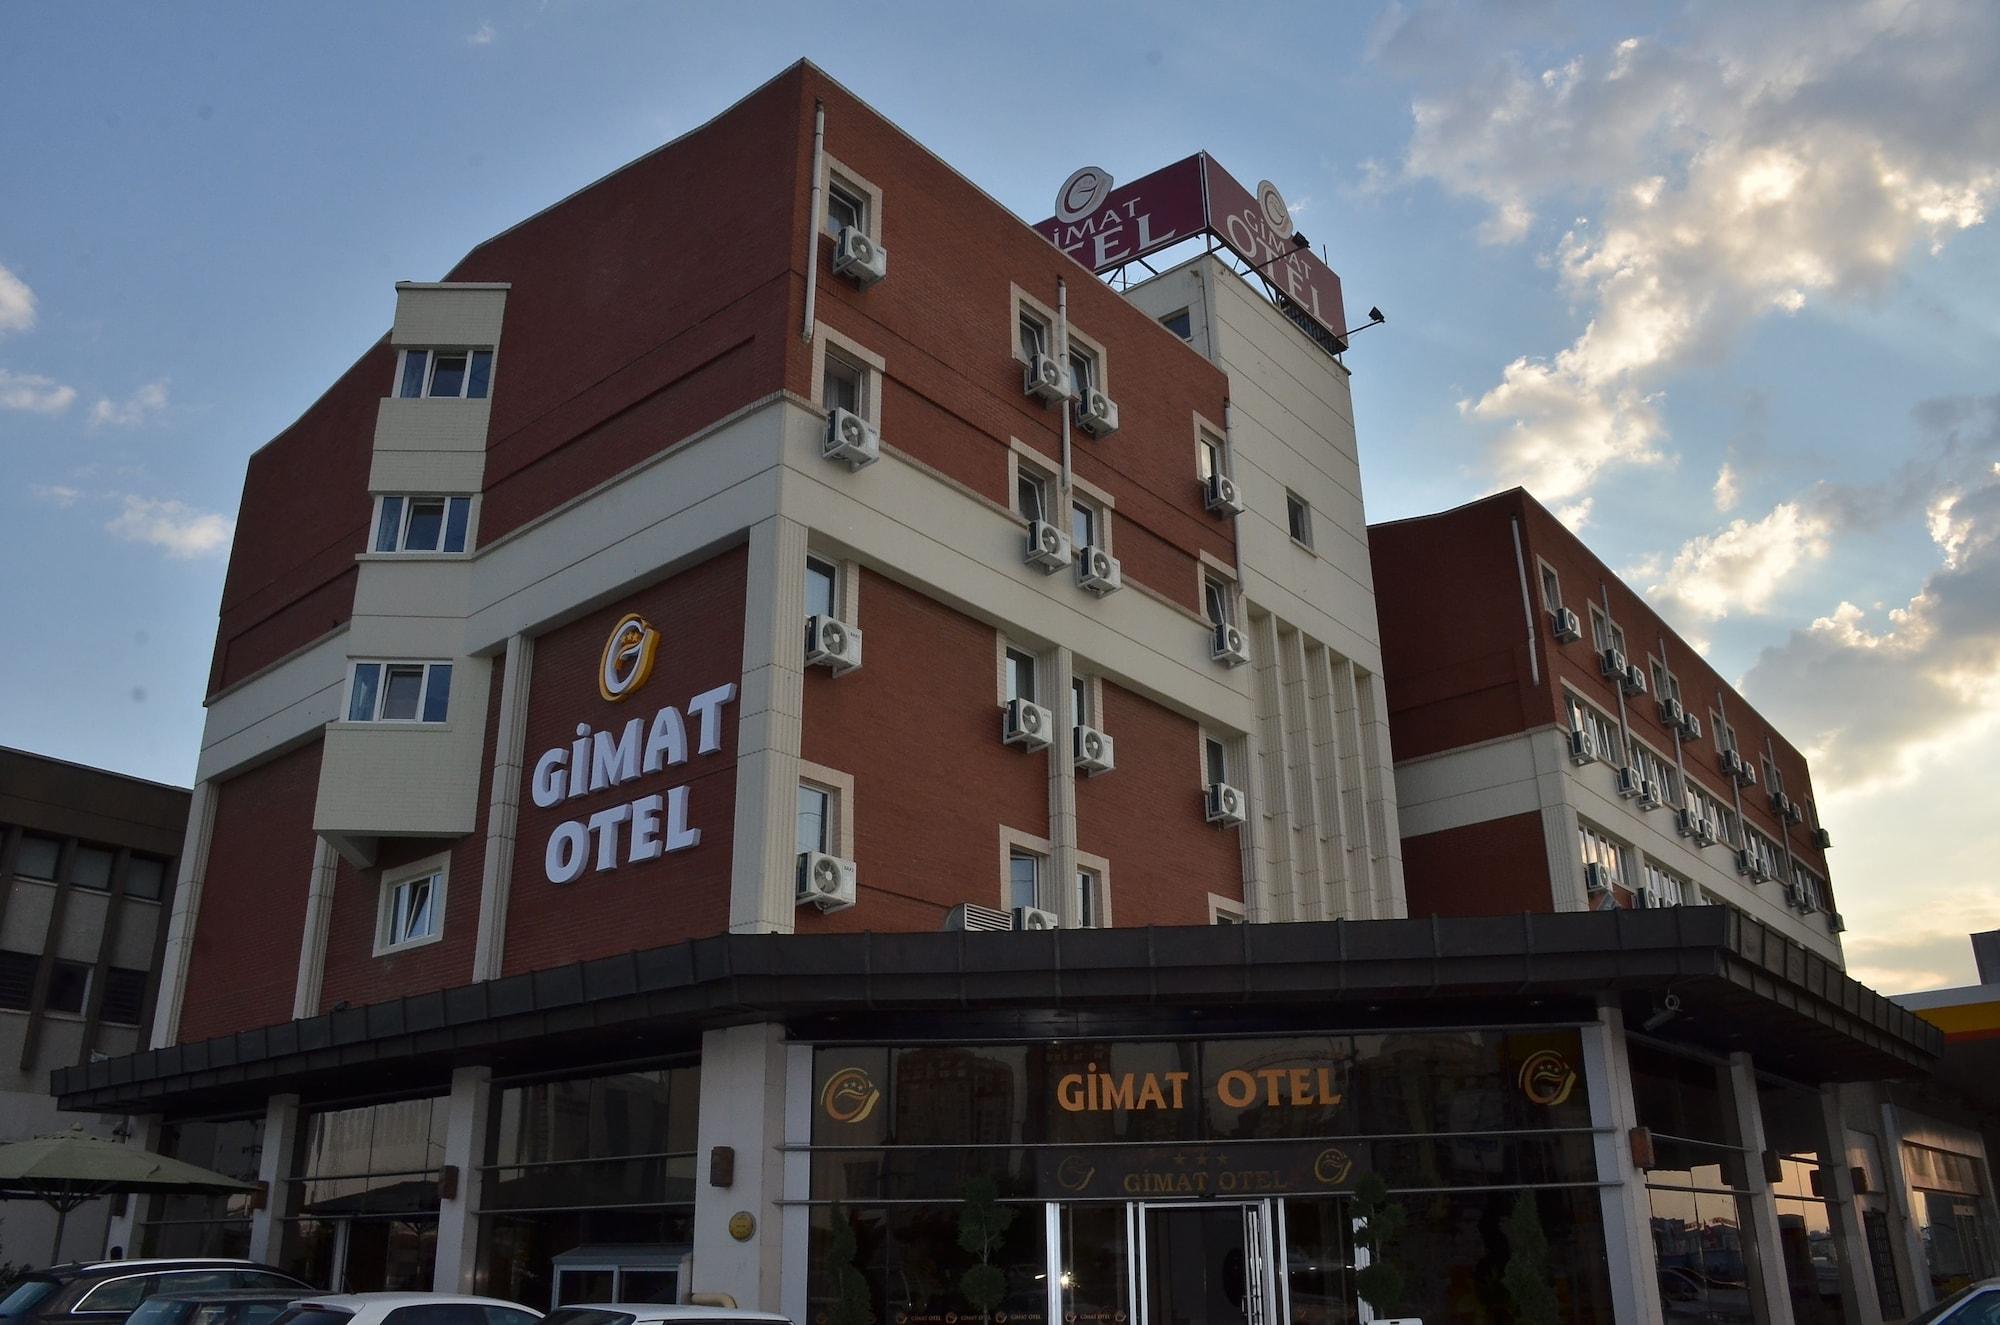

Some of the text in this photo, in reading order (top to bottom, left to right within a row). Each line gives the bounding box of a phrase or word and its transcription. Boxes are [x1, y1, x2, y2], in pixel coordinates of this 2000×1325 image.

[1053, 197, 1141, 248] İMAT
[1227, 214, 1333, 330] OTEL
[531, 682, 737, 809] GİMAT
[544, 785, 702, 884] OTEL
[1056, 1062, 1342, 1112] GİMAT OTEL
[1124, 1168, 1288, 1193] GİMAT OTEL
